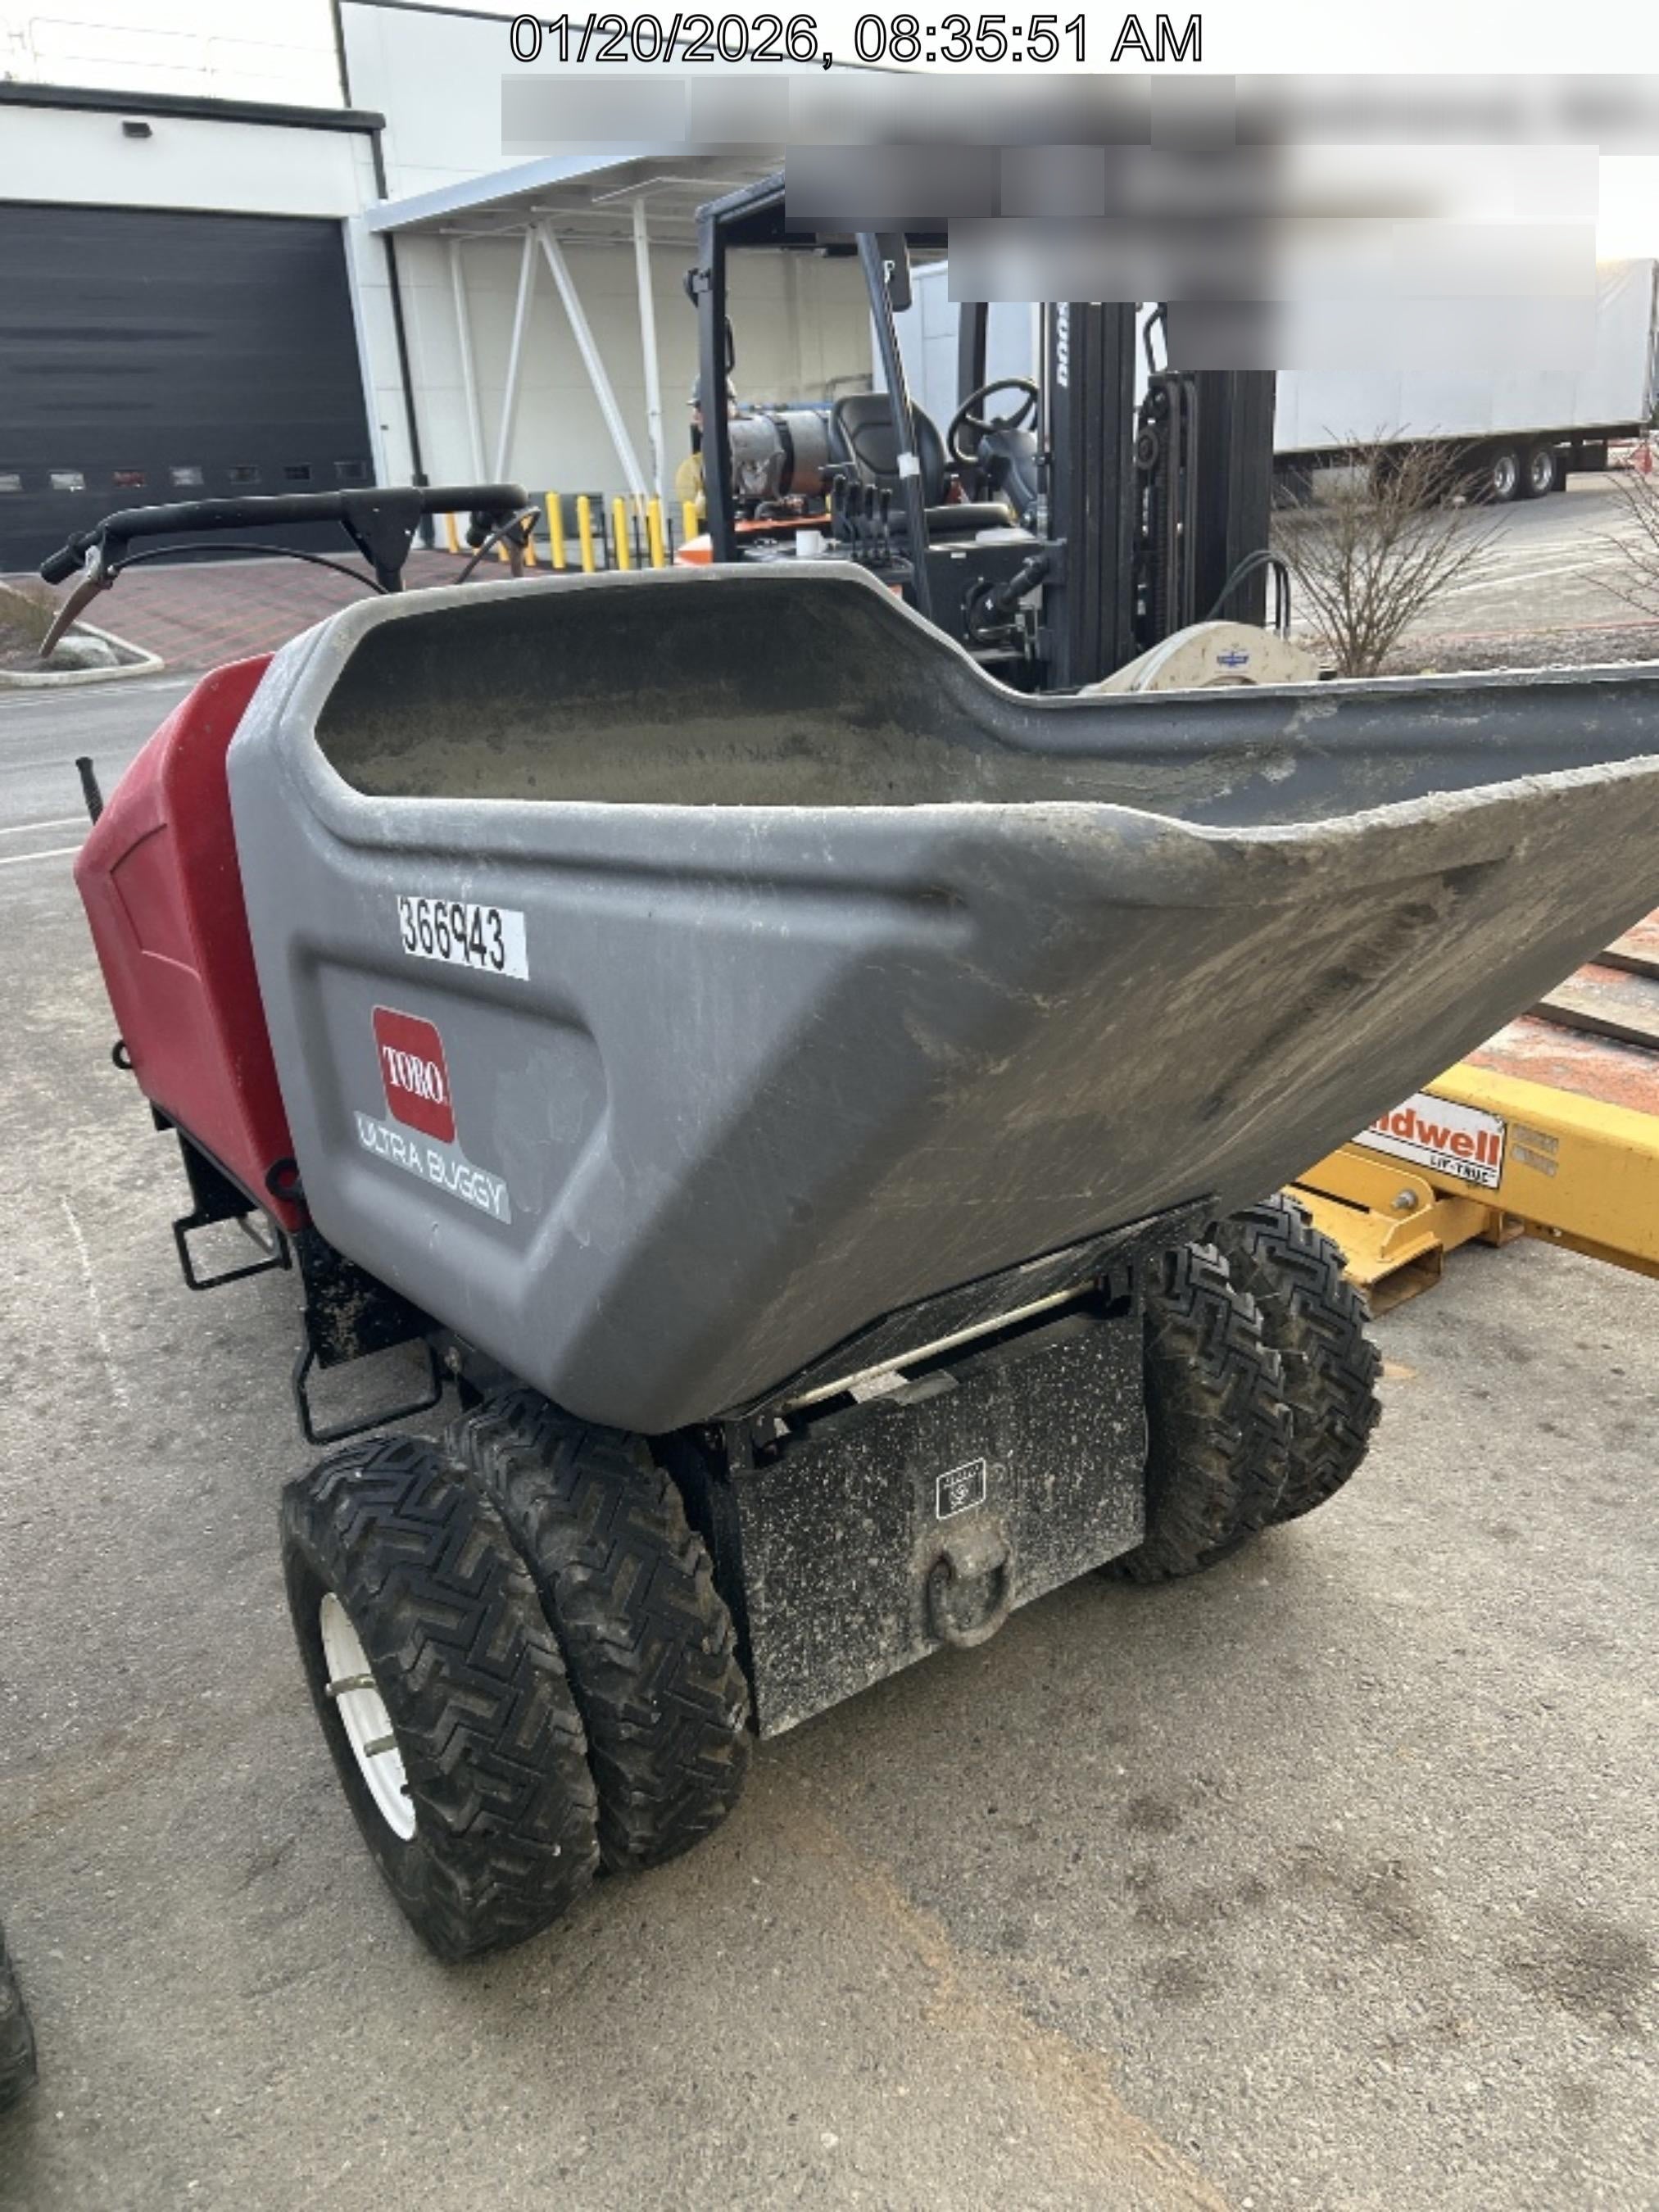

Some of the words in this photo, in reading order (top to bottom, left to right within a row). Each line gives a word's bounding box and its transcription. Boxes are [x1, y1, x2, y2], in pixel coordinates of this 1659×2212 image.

[400, 899, 505, 971] 366943
[383, 1045, 444, 1104] TORO
[358, 1117, 423, 1173] ULTRA
[427, 1149, 504, 1215] BUGGY
